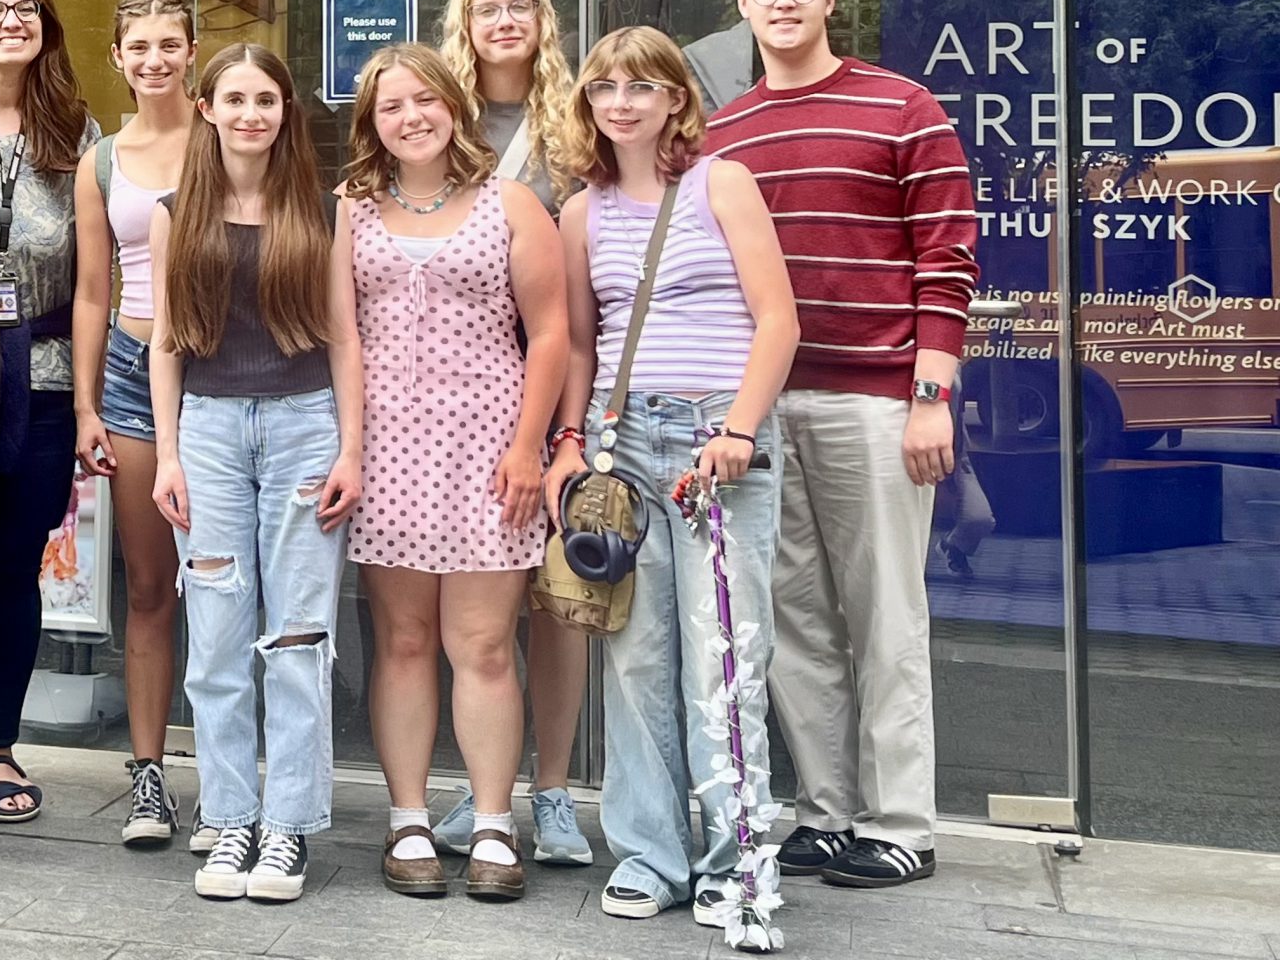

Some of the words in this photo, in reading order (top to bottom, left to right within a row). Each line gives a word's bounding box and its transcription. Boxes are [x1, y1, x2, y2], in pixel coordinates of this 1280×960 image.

[342, 17, 376, 27] Please
[378, 18, 397, 26] use
[347, 31, 366, 41] this
[368, 30, 392, 41] door
[923, 21, 1079, 75] ART
[1096, 38, 1147, 64] OF
[933, 93, 1280, 147] REEDO
[1010, 177, 1083, 202] LIF
[1100, 178, 1122, 204] &
[1137, 178, 1259, 206] WORK
[975, 212, 1051, 238] THU
[1092, 213, 1192, 241] SZYK
[985, 285, 1002, 301] is
[1008, 290, 1033, 303] no
[1039, 291, 1061, 304] us
[1080, 288, 1169, 311] painting
[966, 317, 1035, 334] scapes
[1084, 320, 1143, 335] more.
[1148, 318, 1186, 337] Art
[1191, 323, 1246, 339] must
[1083, 345, 1115, 362] ike
[1120, 348, 1237, 372] everything
